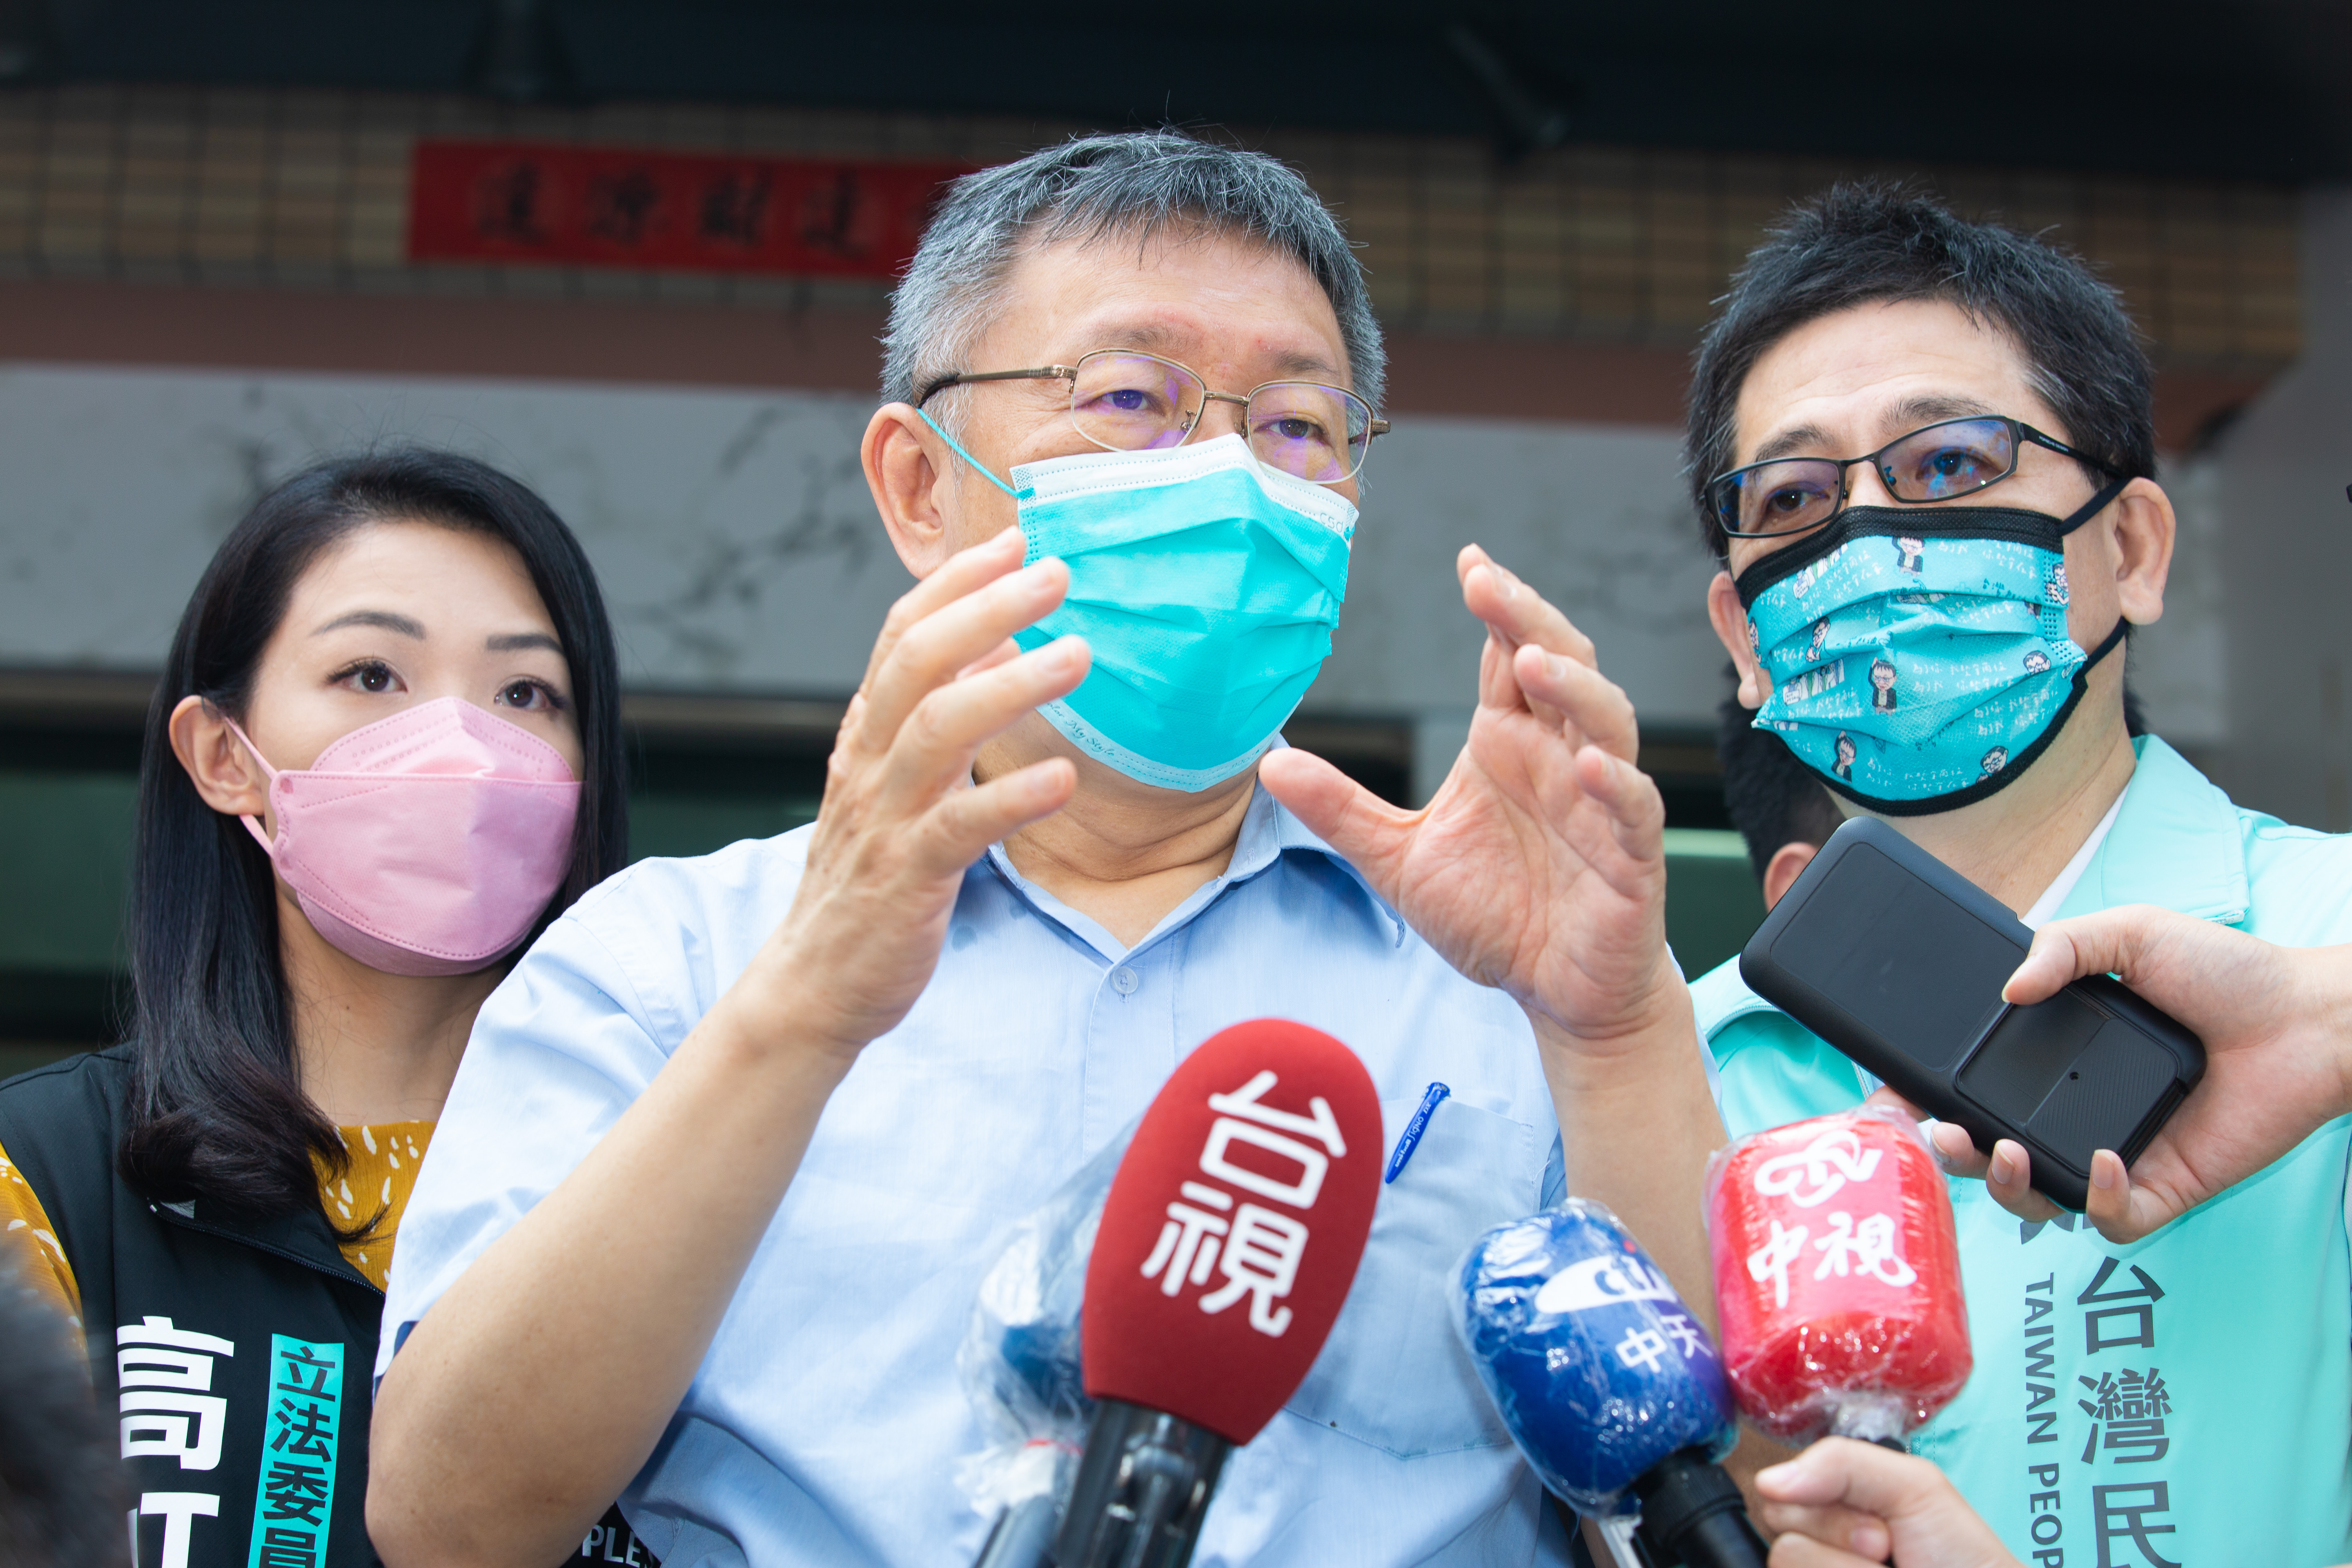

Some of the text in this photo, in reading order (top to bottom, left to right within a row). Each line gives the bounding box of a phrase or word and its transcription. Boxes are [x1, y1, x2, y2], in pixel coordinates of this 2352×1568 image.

[1047, 702, 1115, 756] olor My Style
[1423, 1103, 1431, 1114] DX
[1140, 1069, 1347, 1337] 台視
[1746, 1211, 1918, 1309] 中視
[1615, 1314, 1713, 1373] 中天
[2024, 1272, 2058, 1444] TAIWAN
[261, 1345, 336, 1568] 立法委員
[2077, 1256, 2182, 1568] 台灣民
